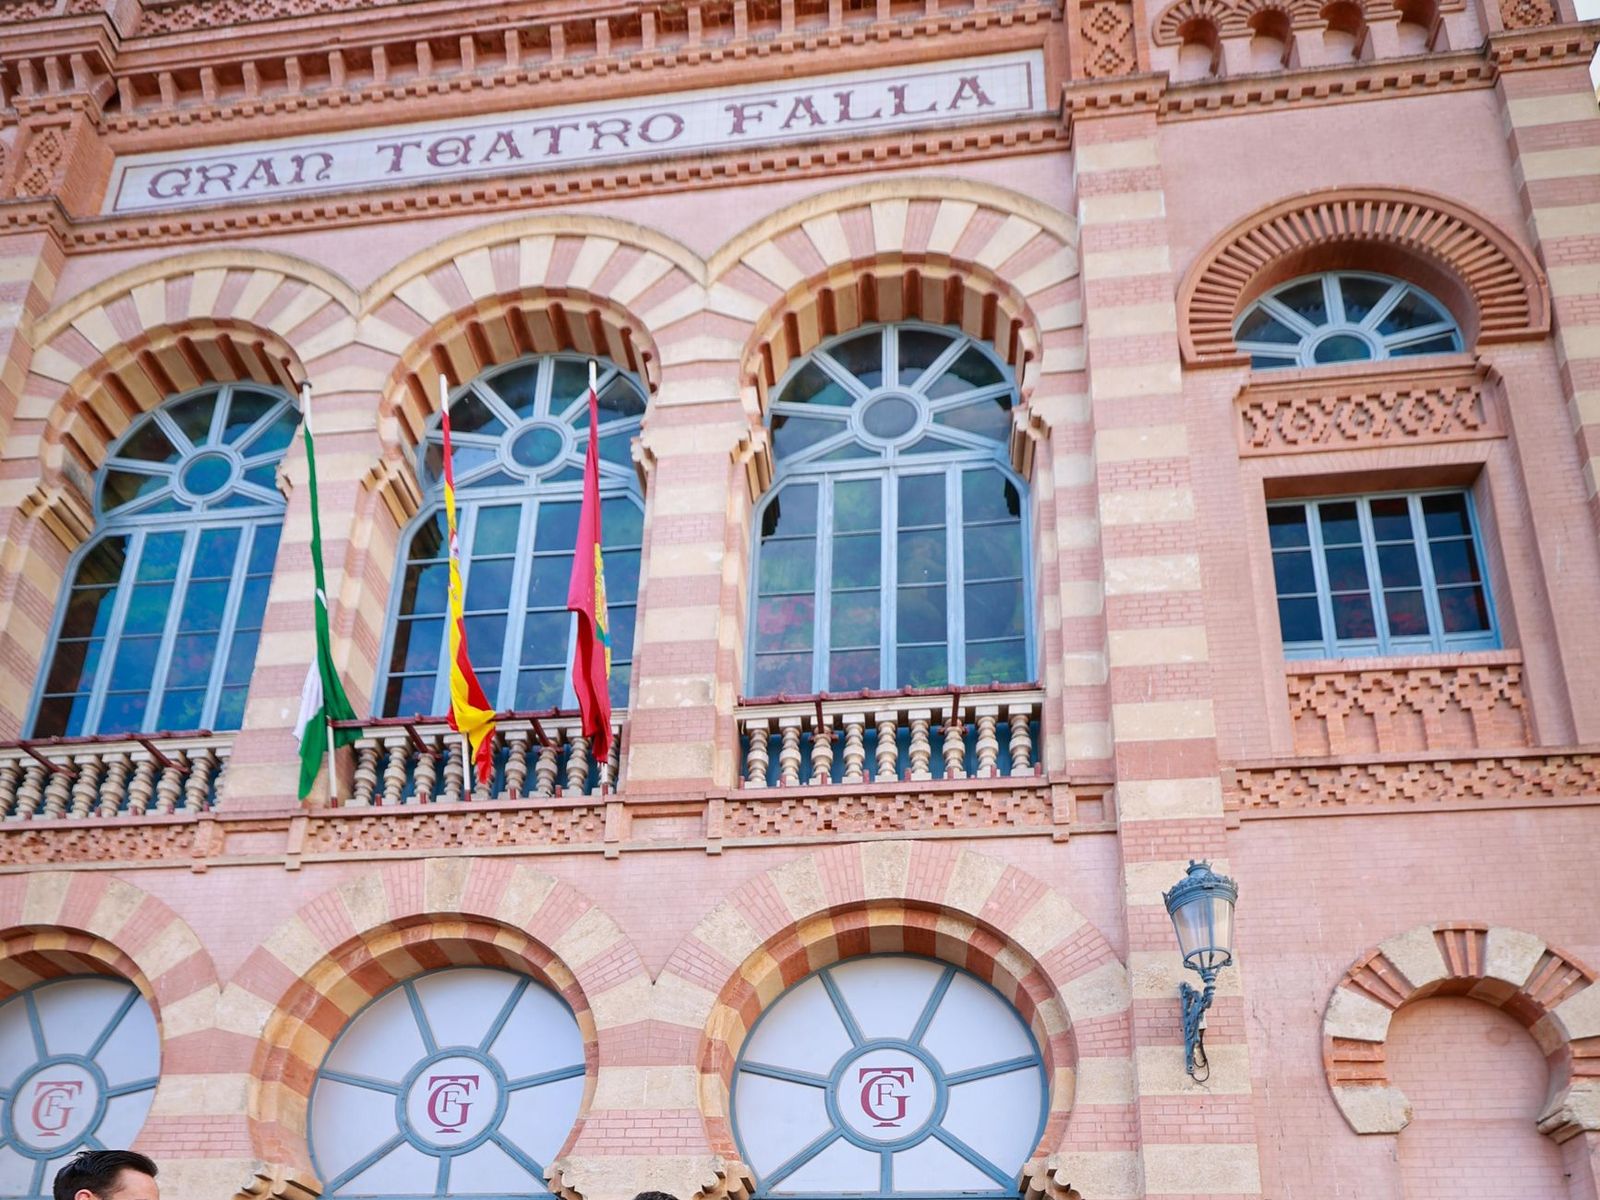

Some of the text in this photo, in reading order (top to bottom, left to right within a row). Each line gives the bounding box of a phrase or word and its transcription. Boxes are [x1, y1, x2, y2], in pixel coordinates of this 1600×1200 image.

[147, 75, 996, 199] GRAN TEATRO FALLA
